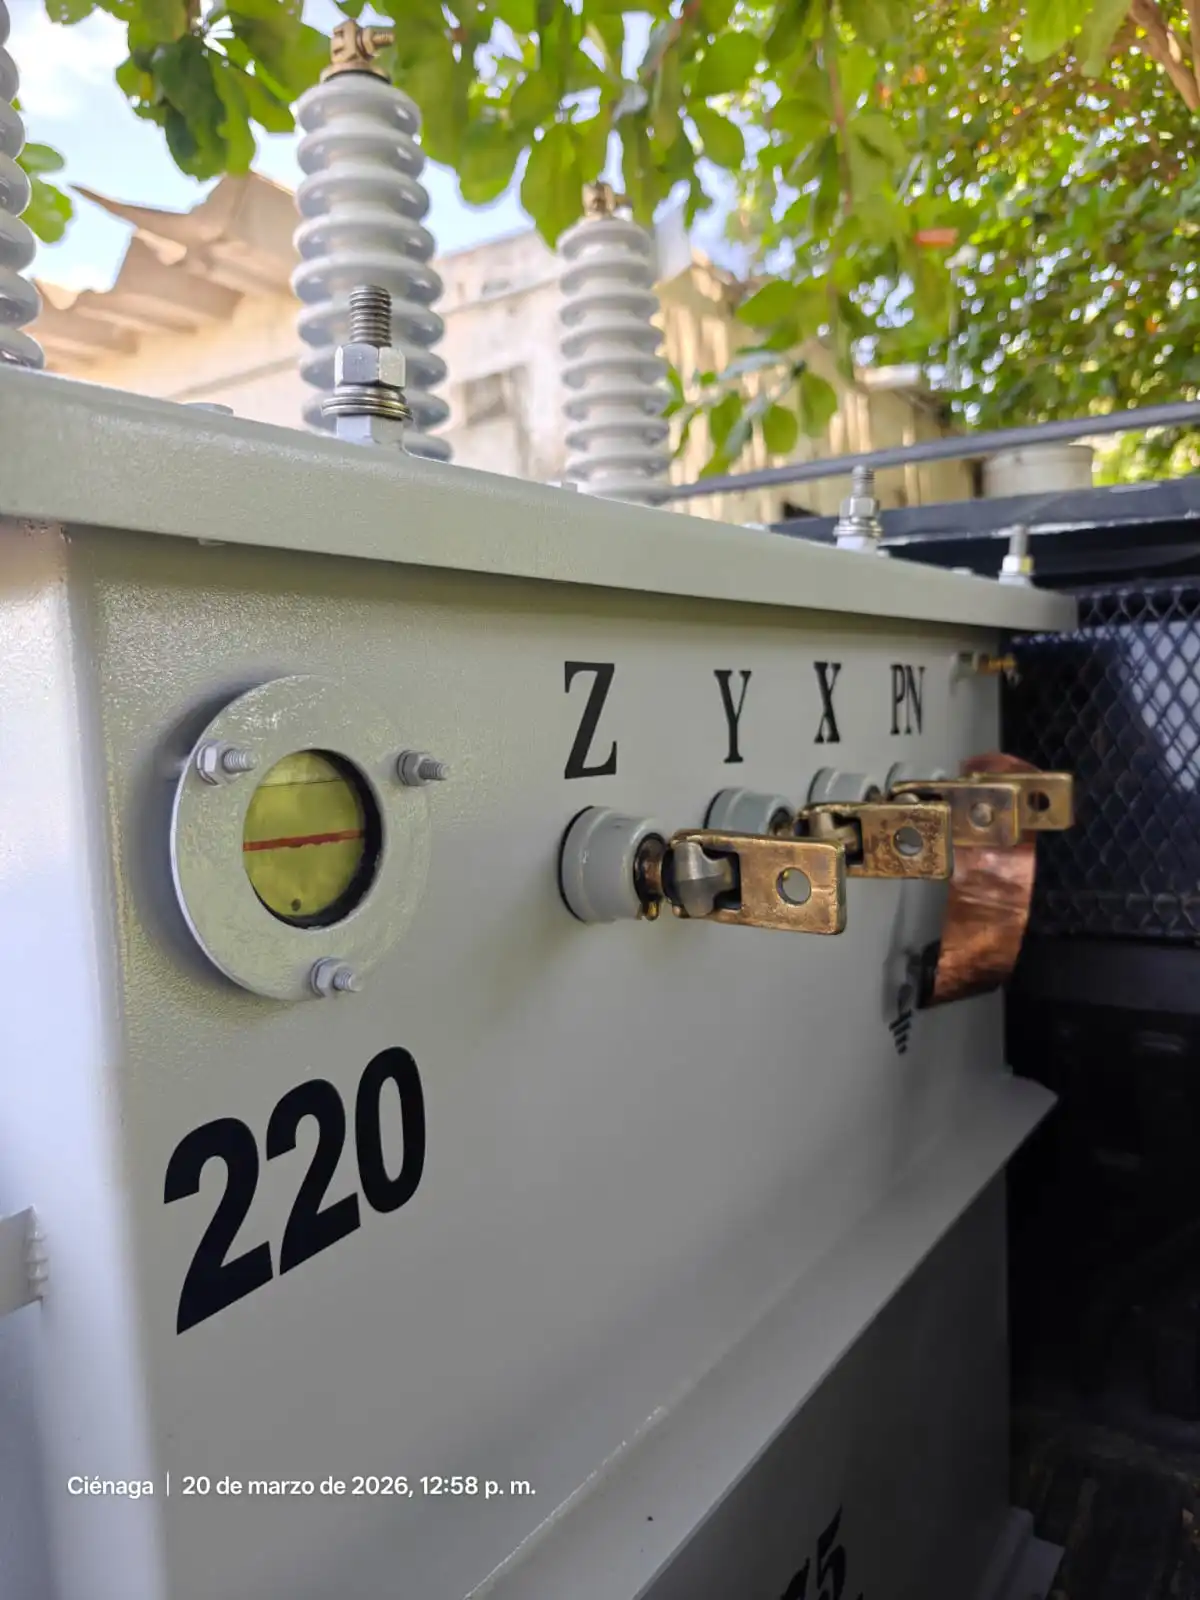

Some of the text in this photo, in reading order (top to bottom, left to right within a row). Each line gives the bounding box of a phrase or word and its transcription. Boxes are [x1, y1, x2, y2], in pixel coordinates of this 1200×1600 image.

[564, 661, 925, 779] Z Y X PN
[163, 1046, 426, 1335] 220
